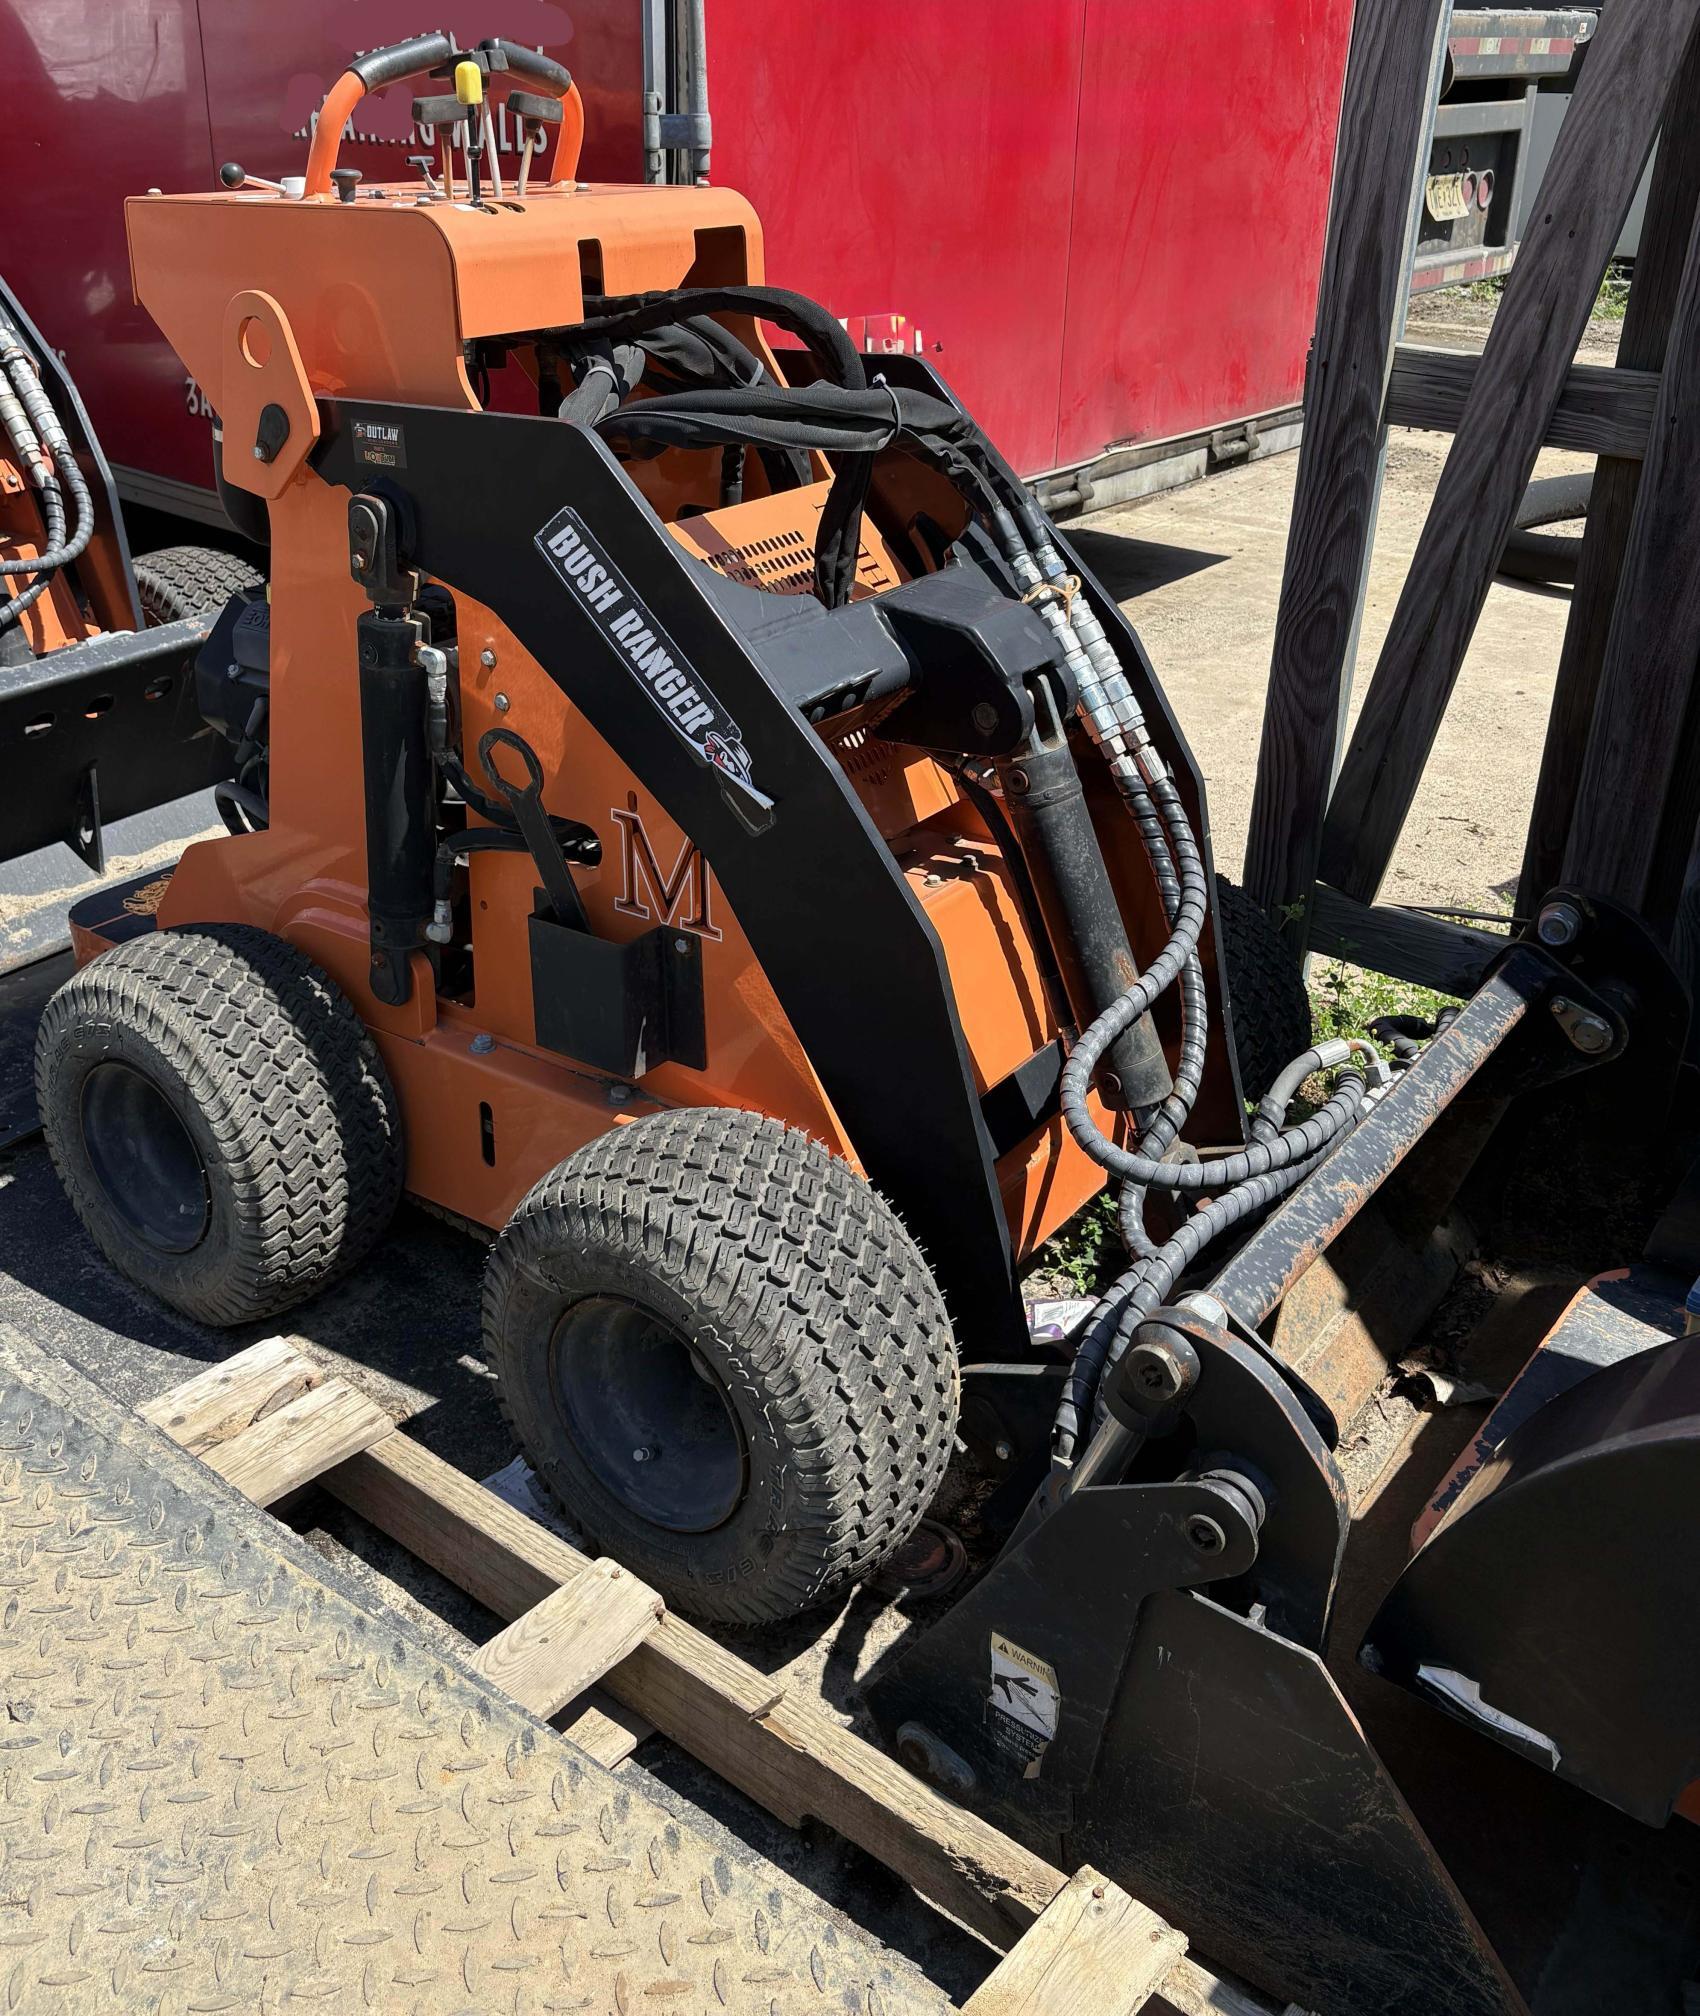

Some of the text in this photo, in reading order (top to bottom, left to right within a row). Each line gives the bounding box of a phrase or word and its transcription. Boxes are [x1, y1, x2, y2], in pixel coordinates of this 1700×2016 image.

[366, 425, 399, 442] OUTLAW
[547, 524, 716, 735] BUSH RANGER
